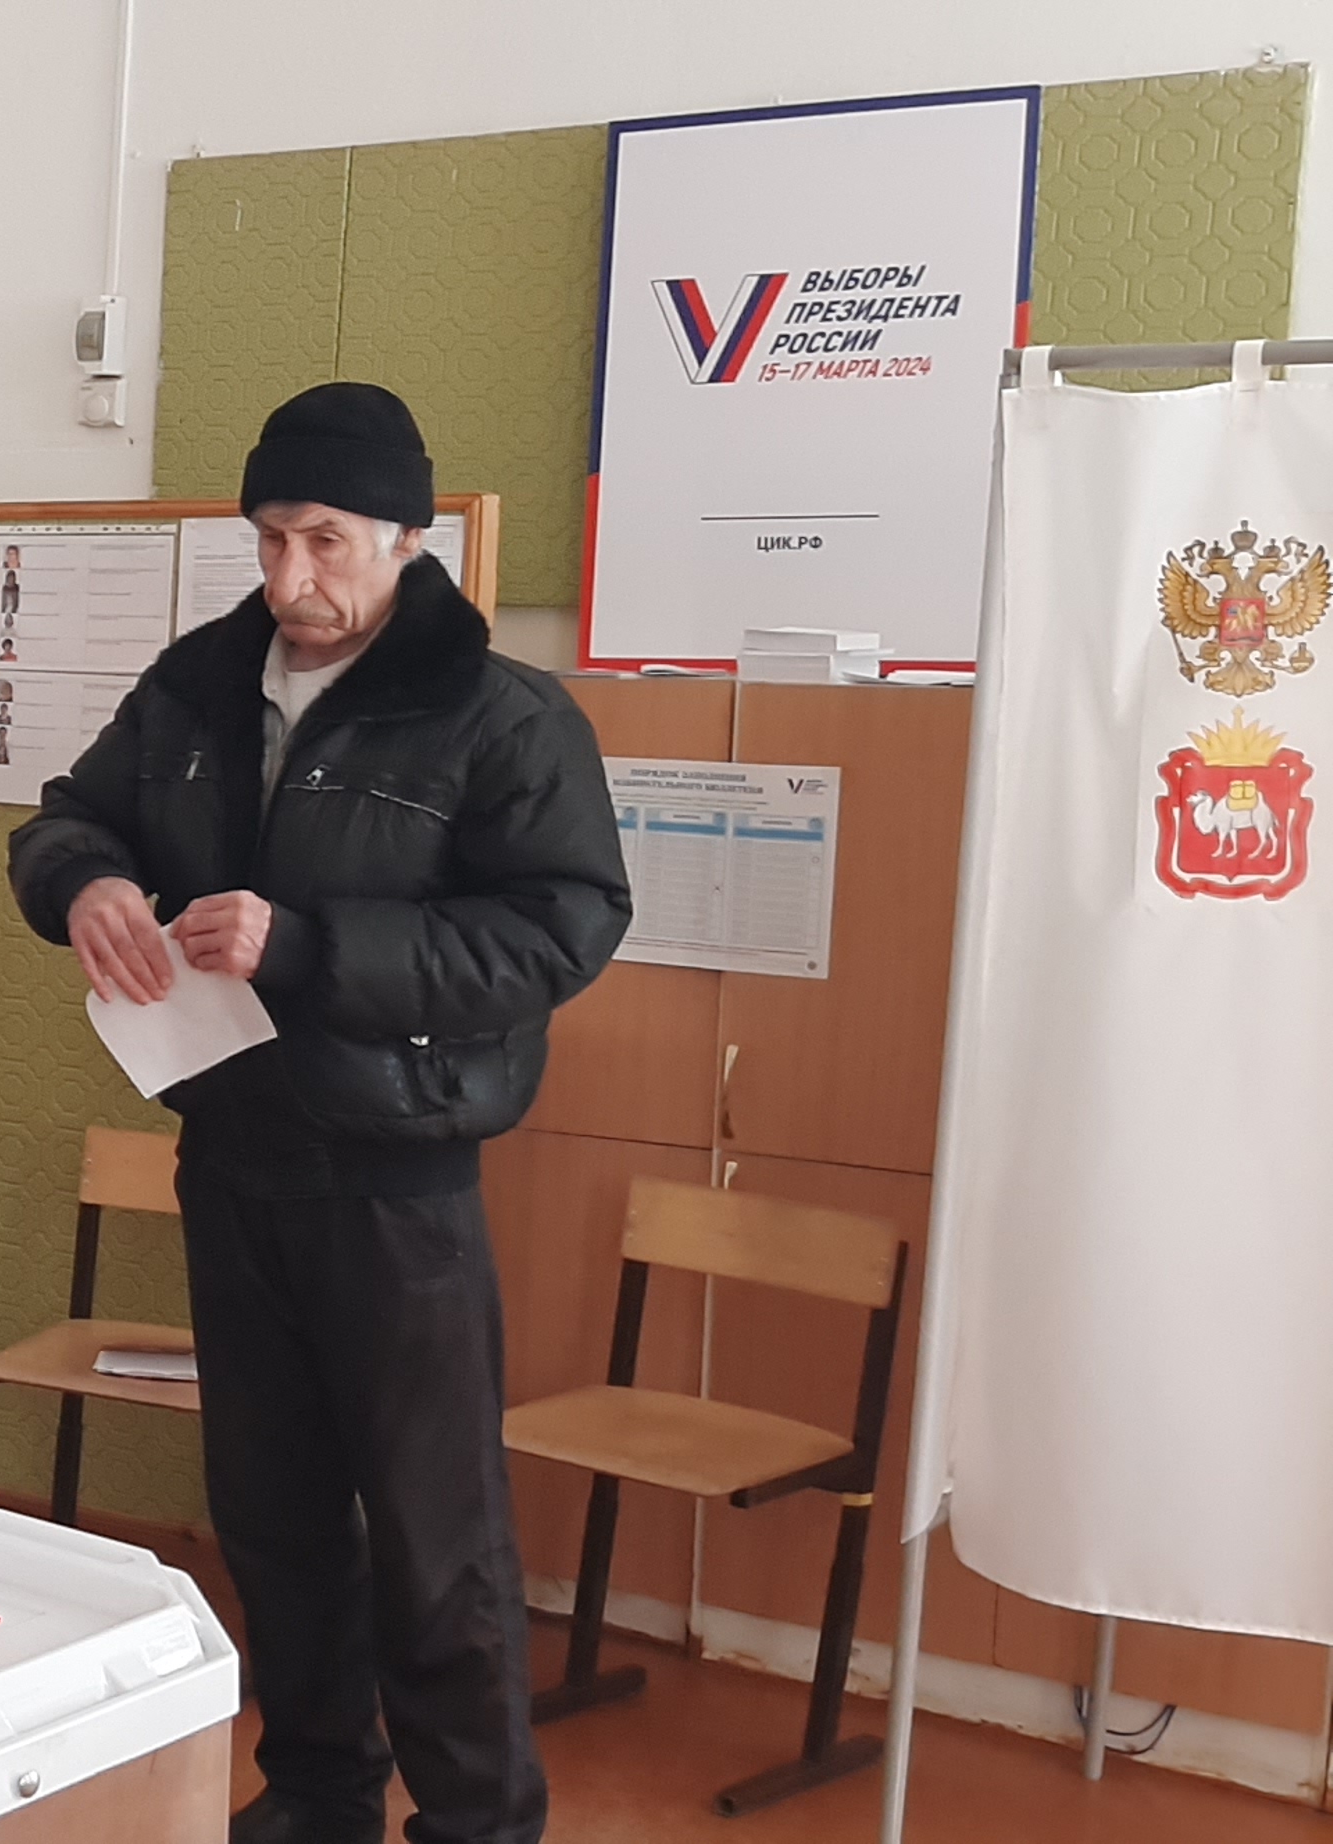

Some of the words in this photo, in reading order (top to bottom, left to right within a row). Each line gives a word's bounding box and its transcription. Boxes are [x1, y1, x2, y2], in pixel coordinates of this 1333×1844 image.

[800, 265, 926, 293] ВЫБОРЫ
[784, 294, 961, 324] ПРЕЗИДЕНТА
[770, 329, 882, 355] РОССИИ
[812, 359, 881, 381] МАРТА
[883, 356, 931, 377] 2024
[757, 536, 823, 553] ЦИК.РФ
